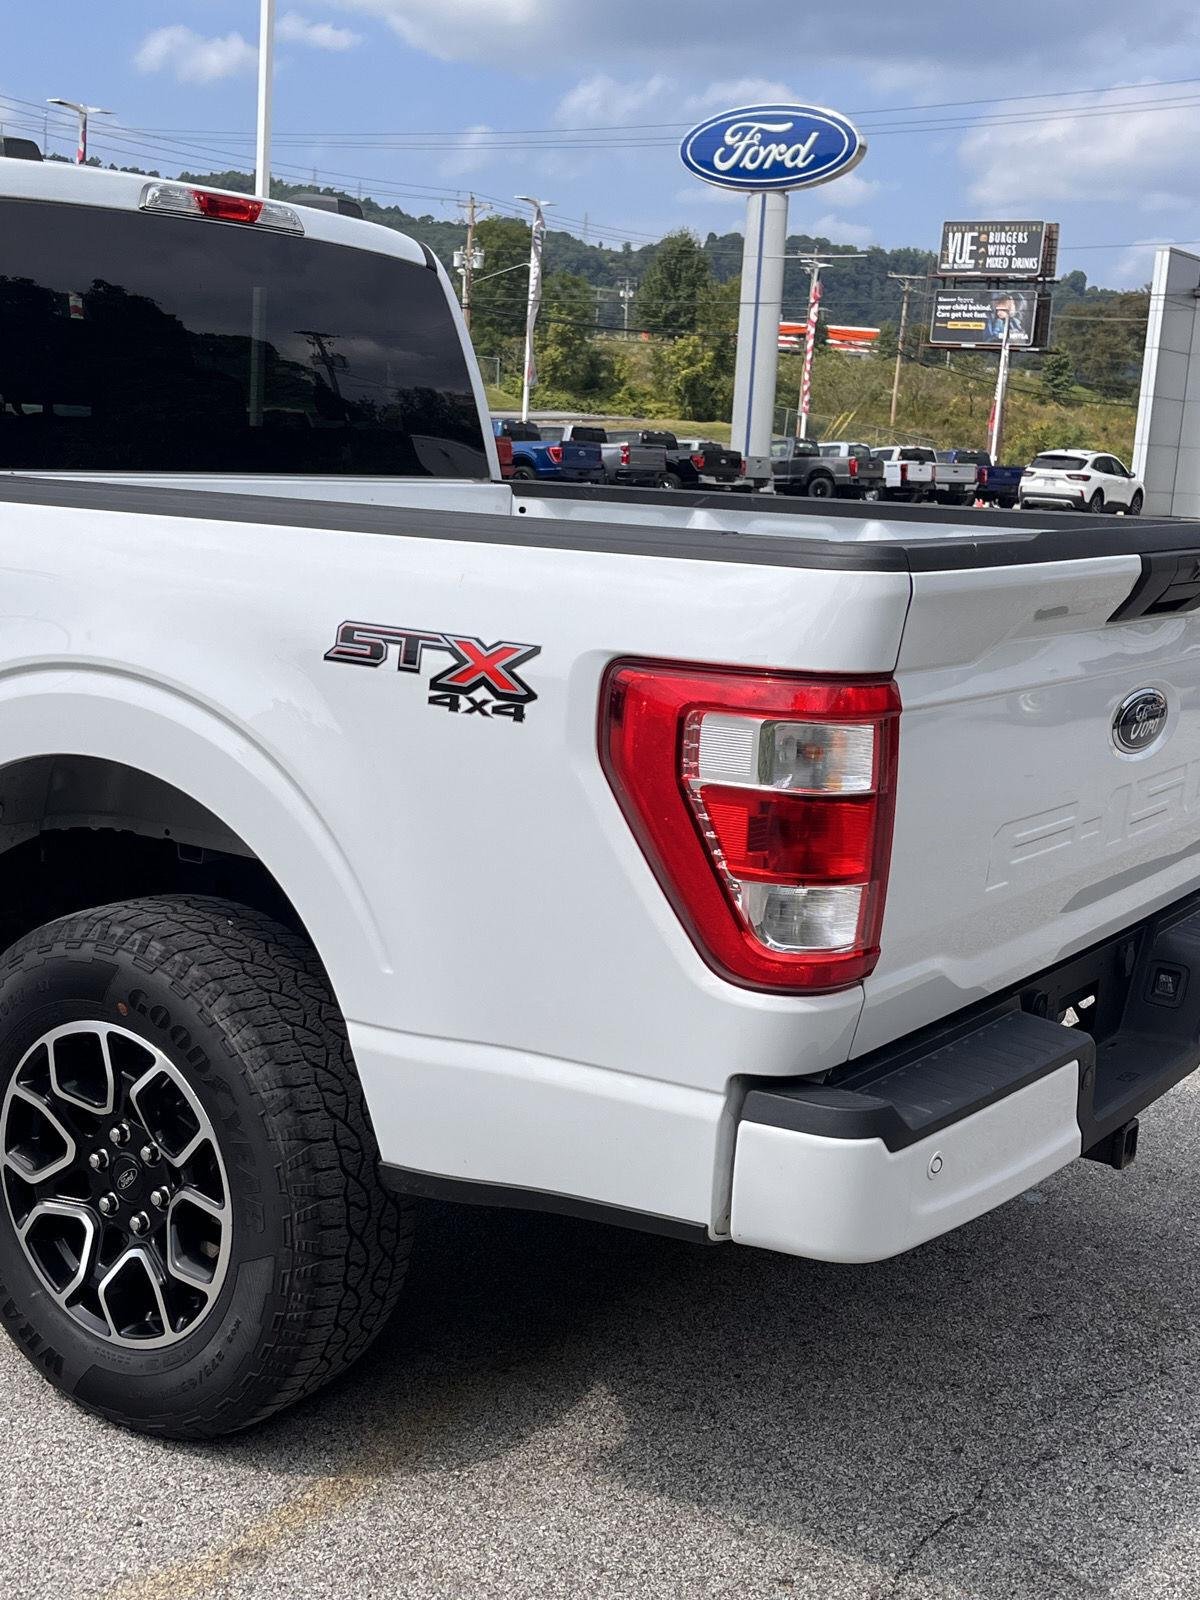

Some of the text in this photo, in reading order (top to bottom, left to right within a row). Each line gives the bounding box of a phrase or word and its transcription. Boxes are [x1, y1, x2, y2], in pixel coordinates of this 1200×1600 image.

[713, 121, 819, 171] Ford
[988, 232, 1028, 244] BURGERS
[948, 232, 979, 264] VUE
[987, 245, 1017, 256] WINGS
[985, 258, 1009, 269] MIXED
[1011, 258, 1038, 269] DRINKS
[952, 303, 969, 311] child
[323, 620, 542, 704] STX
[1129, 698, 1164, 741] Ford
[118, 1170, 135, 1188] Ford
